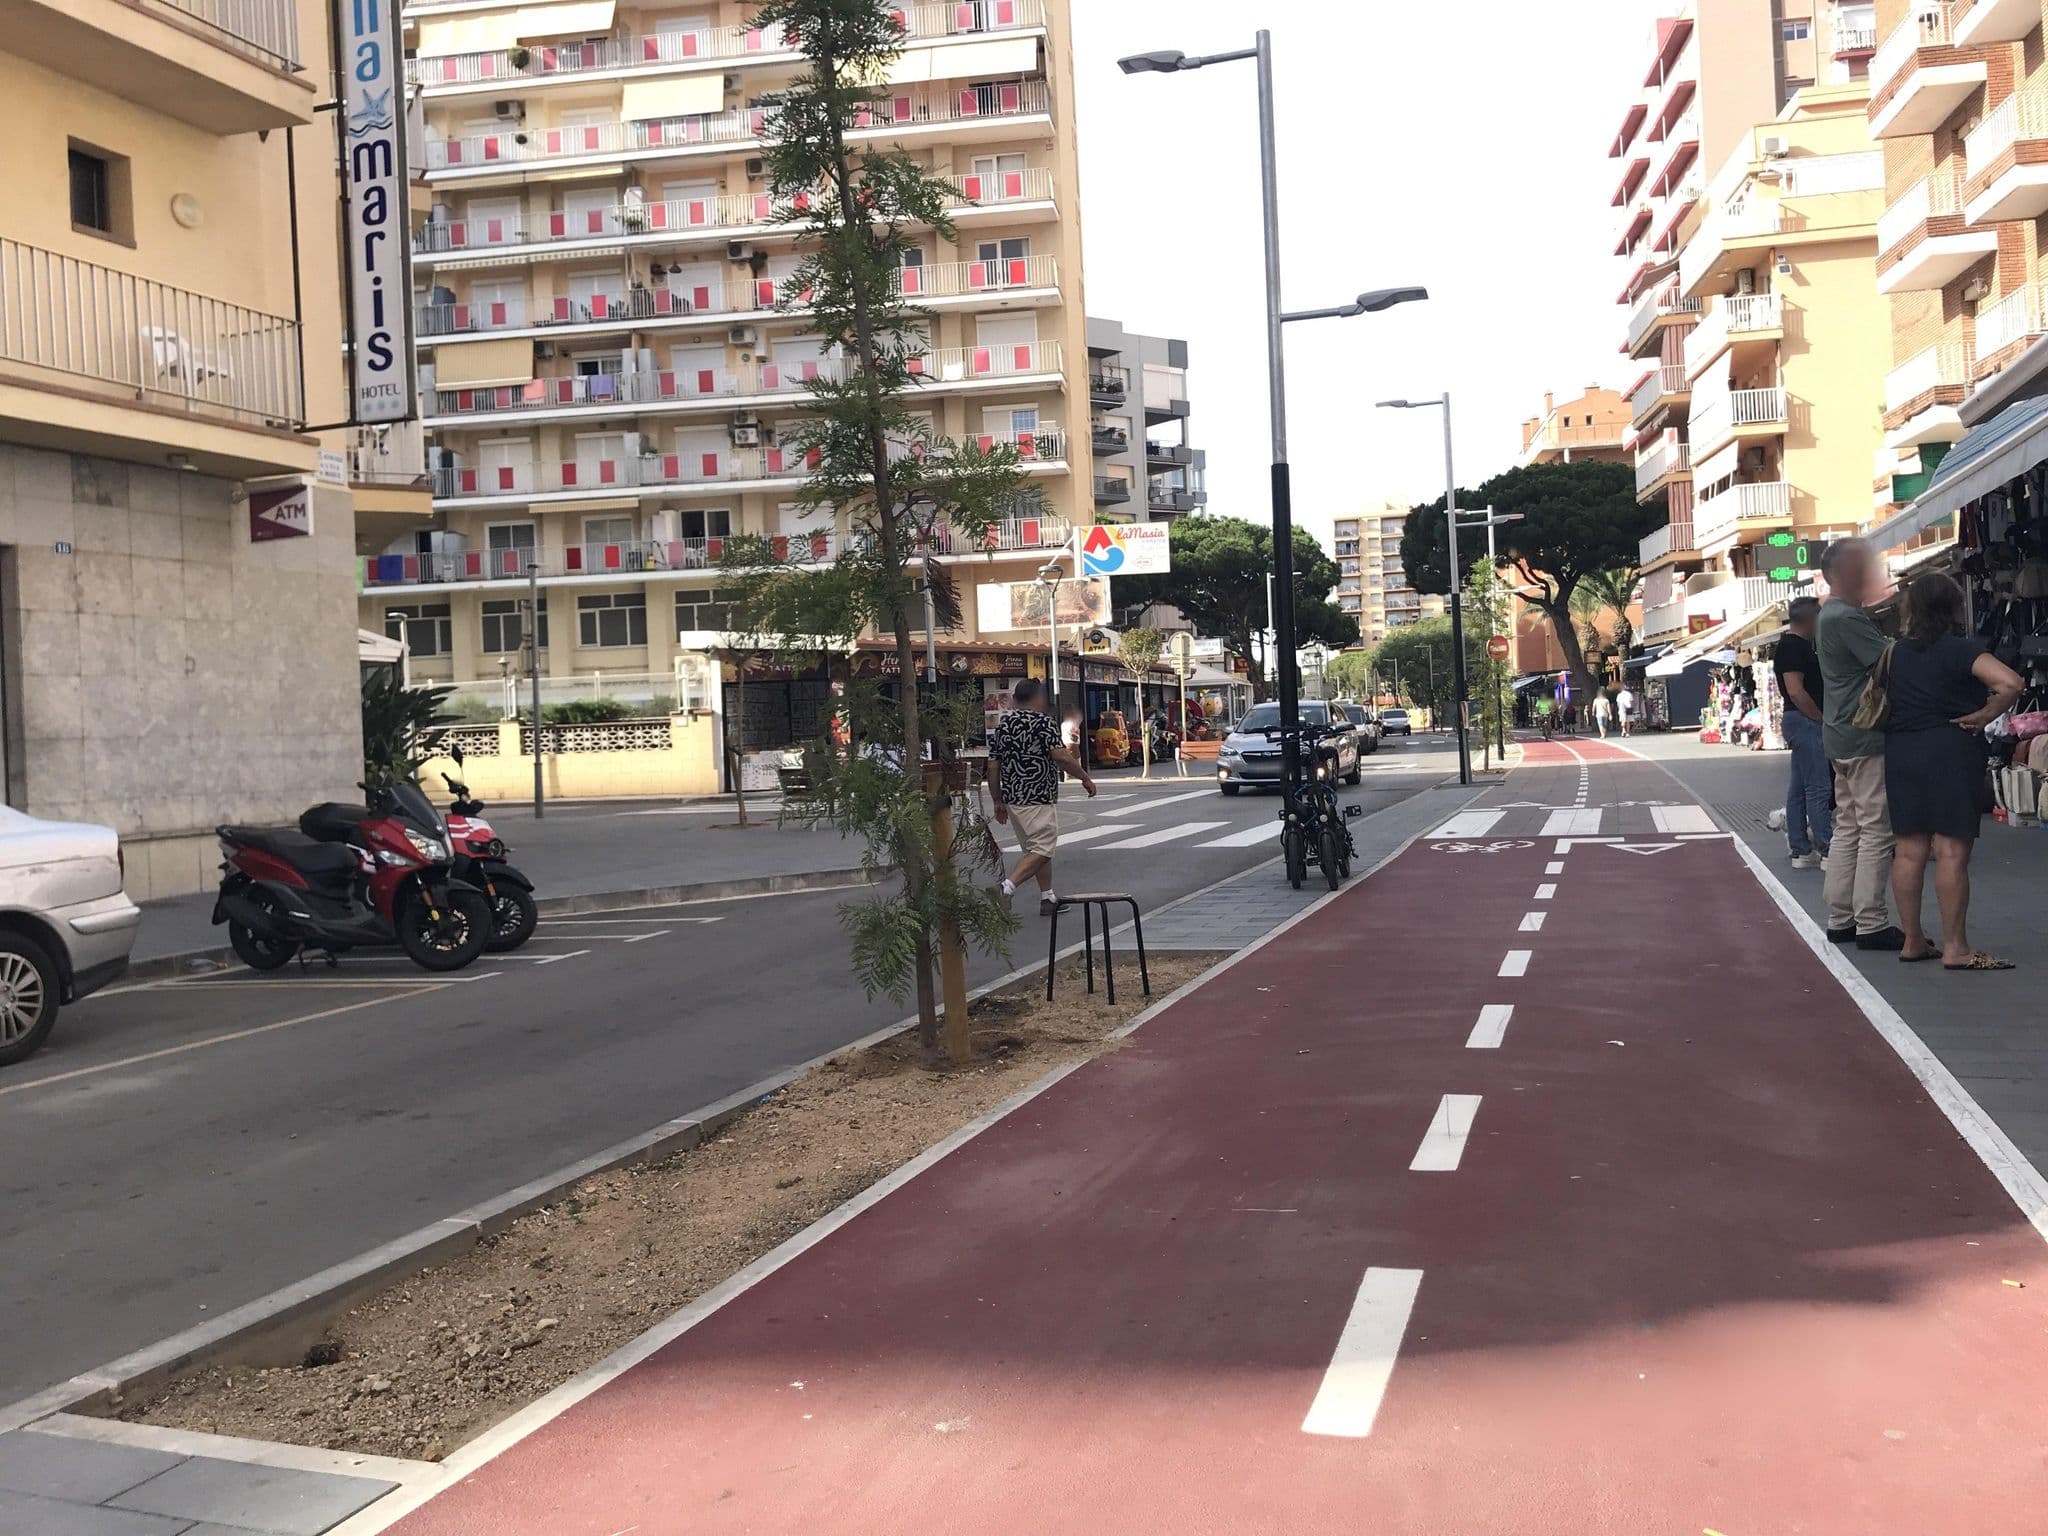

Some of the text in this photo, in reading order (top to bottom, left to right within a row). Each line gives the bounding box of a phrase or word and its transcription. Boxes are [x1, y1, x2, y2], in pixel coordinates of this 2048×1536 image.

[353, 138, 393, 371] maris
[361, 383, 400, 400] HOTEL
[274, 503, 306, 521] ATM
